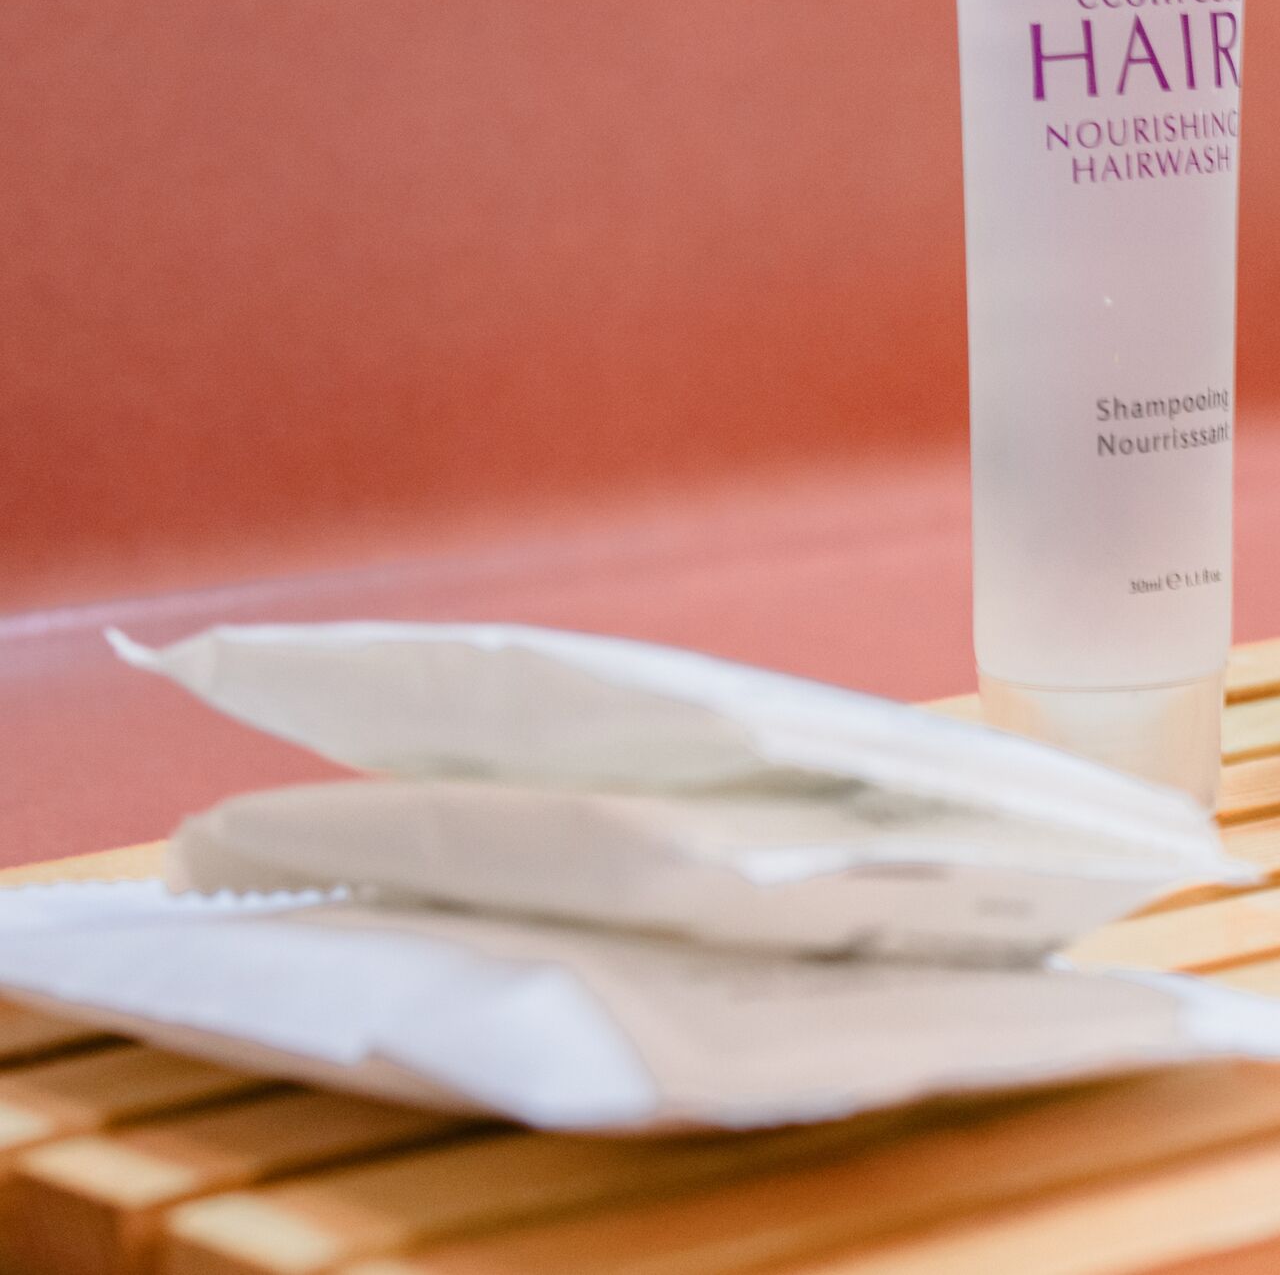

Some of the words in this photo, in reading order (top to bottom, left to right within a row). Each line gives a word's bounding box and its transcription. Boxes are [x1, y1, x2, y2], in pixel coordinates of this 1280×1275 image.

[1029, 11, 1241, 102] HAIR
[1071, 145, 1231, 185] HAIRWASH
[1096, 387, 1230, 422] Shampooing
